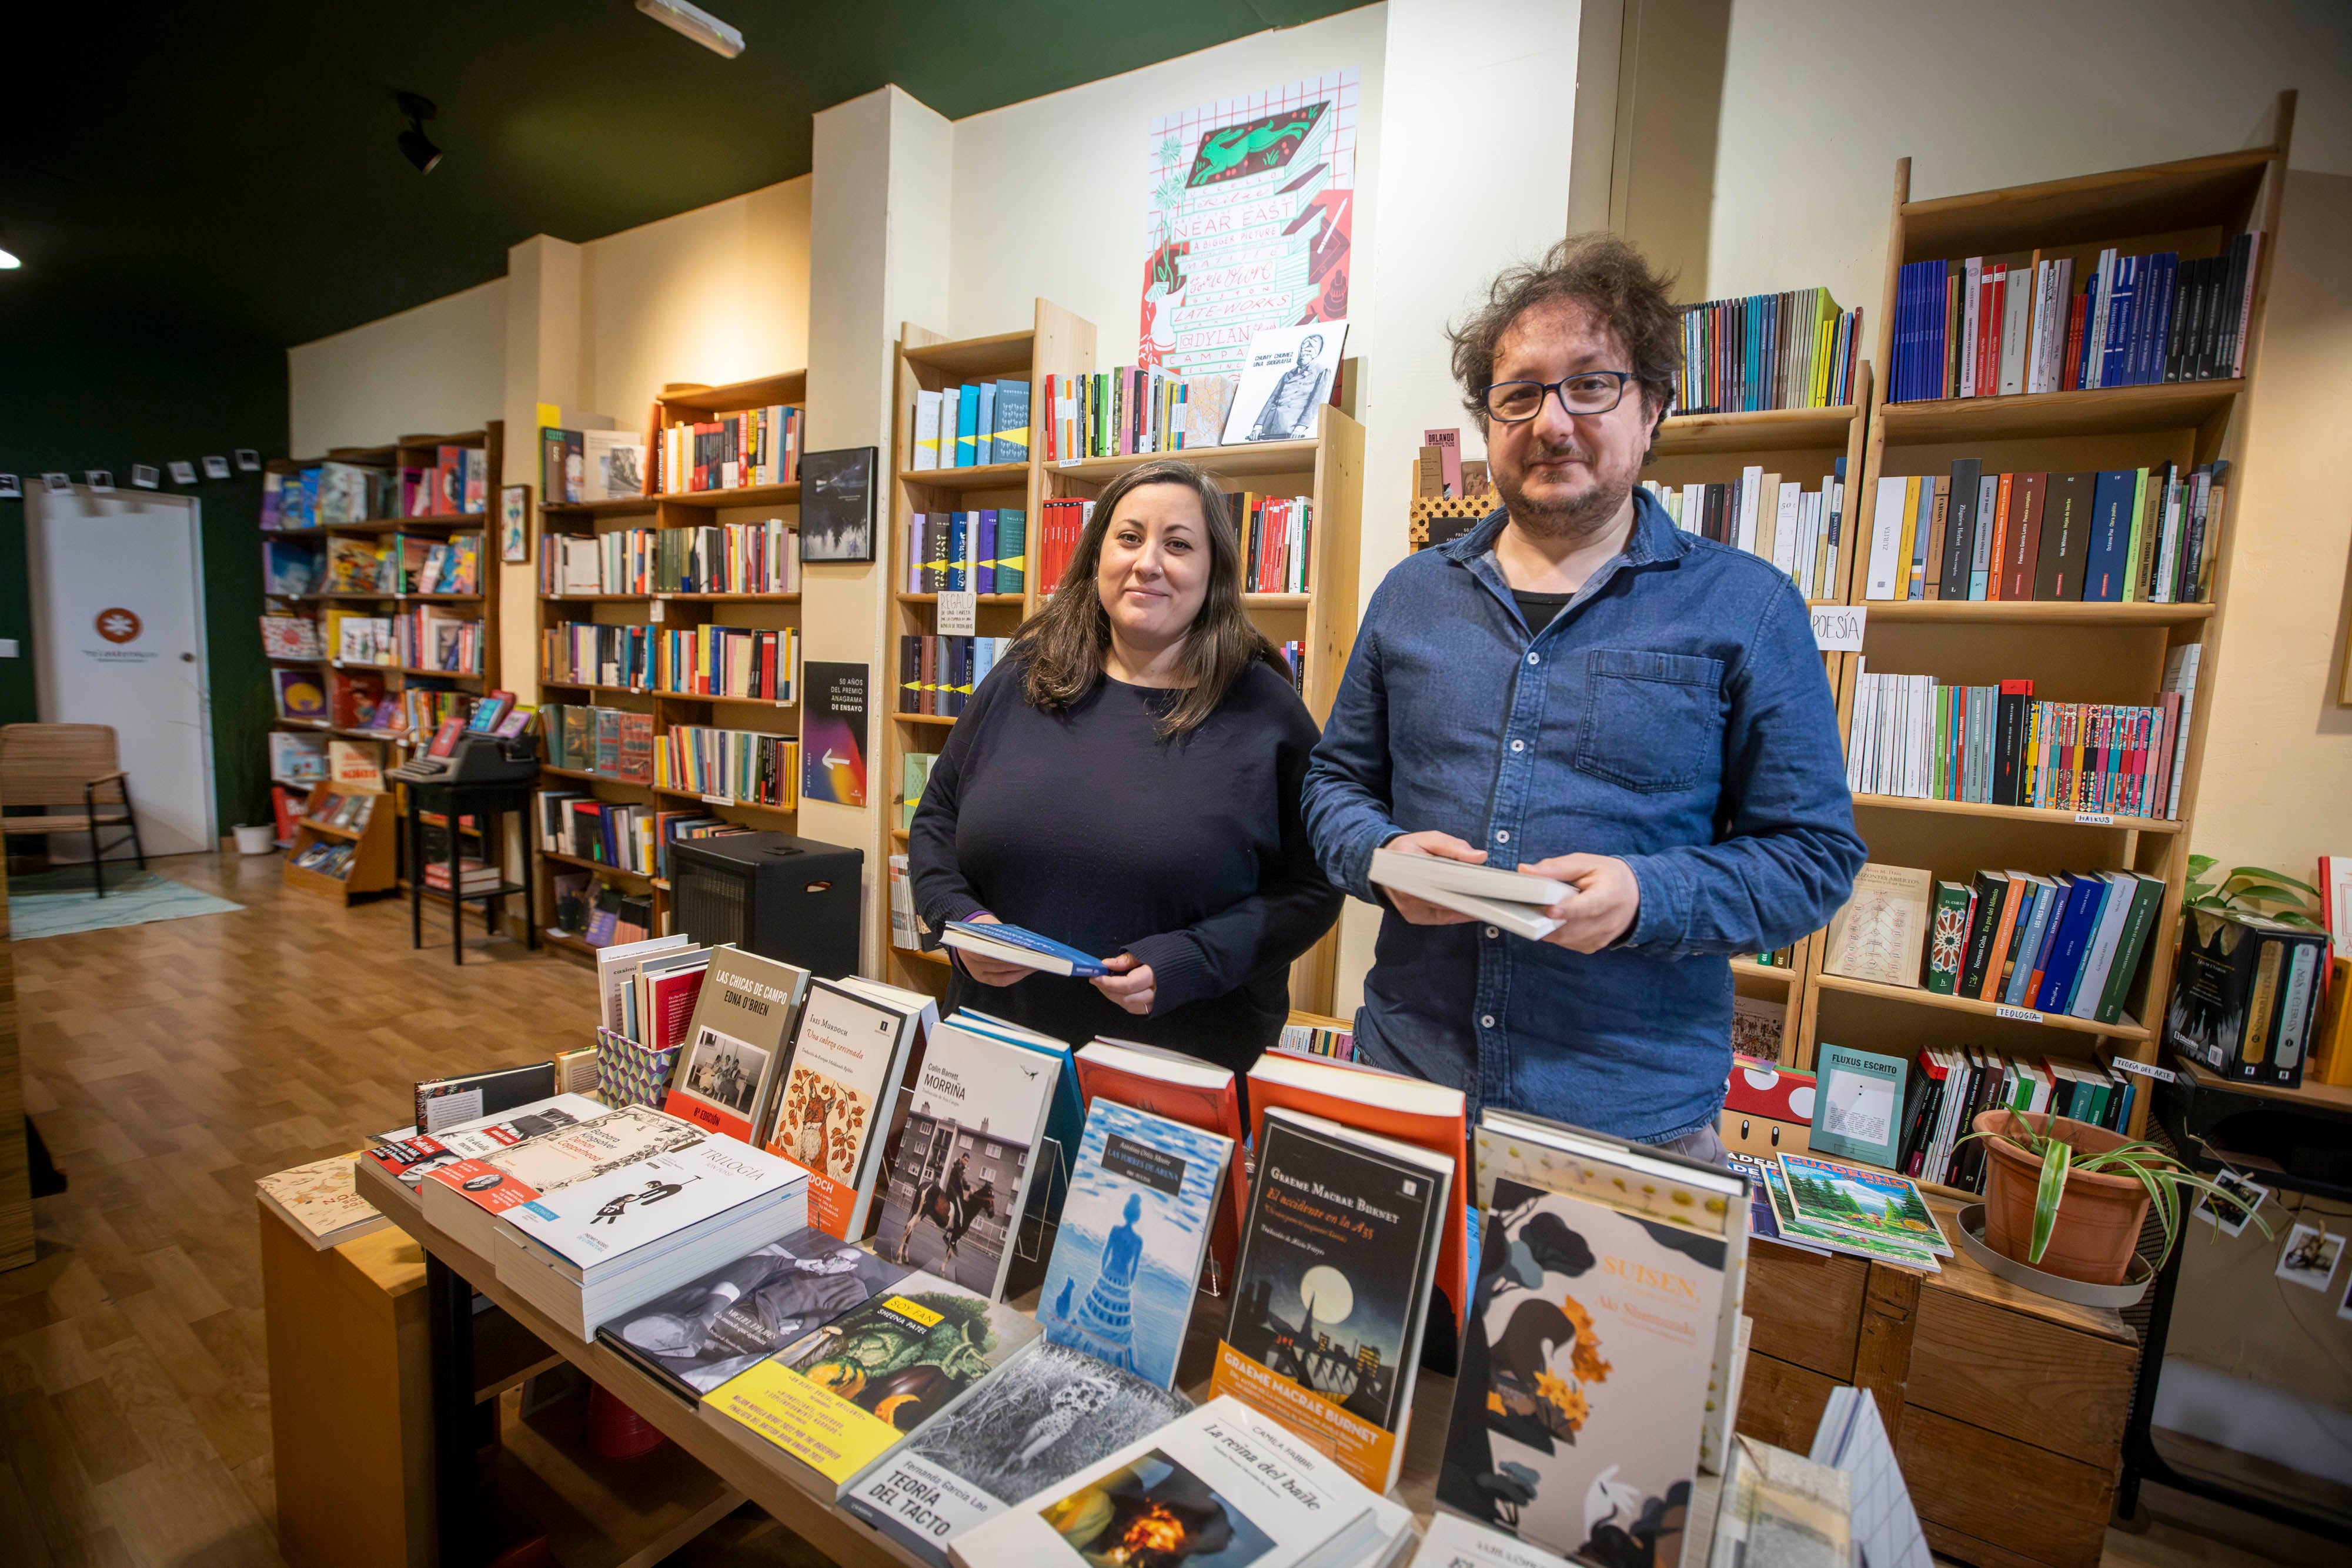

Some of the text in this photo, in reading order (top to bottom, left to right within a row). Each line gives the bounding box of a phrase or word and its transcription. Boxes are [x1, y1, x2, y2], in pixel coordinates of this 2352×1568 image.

[1190, 172, 1277, 197] UCCELLO
[1174, 216, 1231, 240] NEAR
[1243, 202, 1294, 226] EAST
[1194, 242, 1198, 250] A
[1204, 235, 1234, 249] BIGGER
[1241, 227, 1275, 240] PICTURE
[1174, 295, 1289, 322] LATE-WORKS
[1169, 349, 1244, 365] CAMPA
[1429, 433, 1454, 442] ORLANDO
[1955, 504, 1966, 546] Zbigniew Herbert
[1882, 527, 1890, 550] ZURITA
[2140, 541, 2151, 587] VALENTINE PENROSE
[941, 594, 973, 609] REGALO
[1813, 611, 1859, 640] POESÍA
[847, 677, 863, 686] AÑOS
[2078, 815, 2110, 824] HAIKUS
[2038, 889, 2050, 910] MISTERIOS
[2034, 910, 2044, 920] TRES
[1974, 949, 1984, 968] Norman
[1979, 935, 1987, 948] Cohn
[1989, 888, 1999, 907] Milenio
[613, 965, 637, 975] casimi
[716, 969, 788, 1005] LAS CHICAS DE CAMPO
[724, 989, 769, 1017] EDNA O'BRIEN
[807, 1028, 864, 1059] Una cabeza cercenada
[928, 1063, 958, 1081] Colin Barrett
[1832, 1054, 1861, 1068] FLUXUS
[1863, 1060, 1897, 1075] ESCRITO
[2154, 1068, 2171, 1080] ARTE
[924, 1074, 965, 1101] MORRIÑA
[700, 1109, 721, 1126] EDICIÓN
[457, 1142, 475, 1152] menor
[472, 1141, 490, 1151] detalle
[568, 1136, 596, 1149] Demon
[579, 1132, 617, 1149] Kingsolver
[590, 1128, 620, 1142] Barbara
[557, 1139, 604, 1162] Copperhead
[701, 1149, 765, 1181] TRILOGÍA
[1786, 1157, 1909, 1188] CUADERNO
[808, 1175, 834, 1193] DOCH
[1266, 1186, 1351, 1229] El accidente en la
[1603, 1254, 1697, 1298] SUISEN
[877, 1308, 927, 1335] SHEENA PATEL
[891, 1300, 937, 1323] SOY FAN
[1224, 1352, 1271, 1387] GRAEME
[1272, 1380, 1324, 1417] MACRAE
[1325, 1408, 1379, 1446] BURNET
[1252, 1426, 1316, 1471] CAMILA FABBRI
[1203, 1424, 1321, 1510] La reina del baile
[887, 1470, 941, 1507] TEORÍA
[903, 1461, 941, 1484] Fernanda
[941, 1480, 970, 1502] García
[868, 1483, 900, 1506] DEL
[899, 1499, 951, 1537] TACTO
